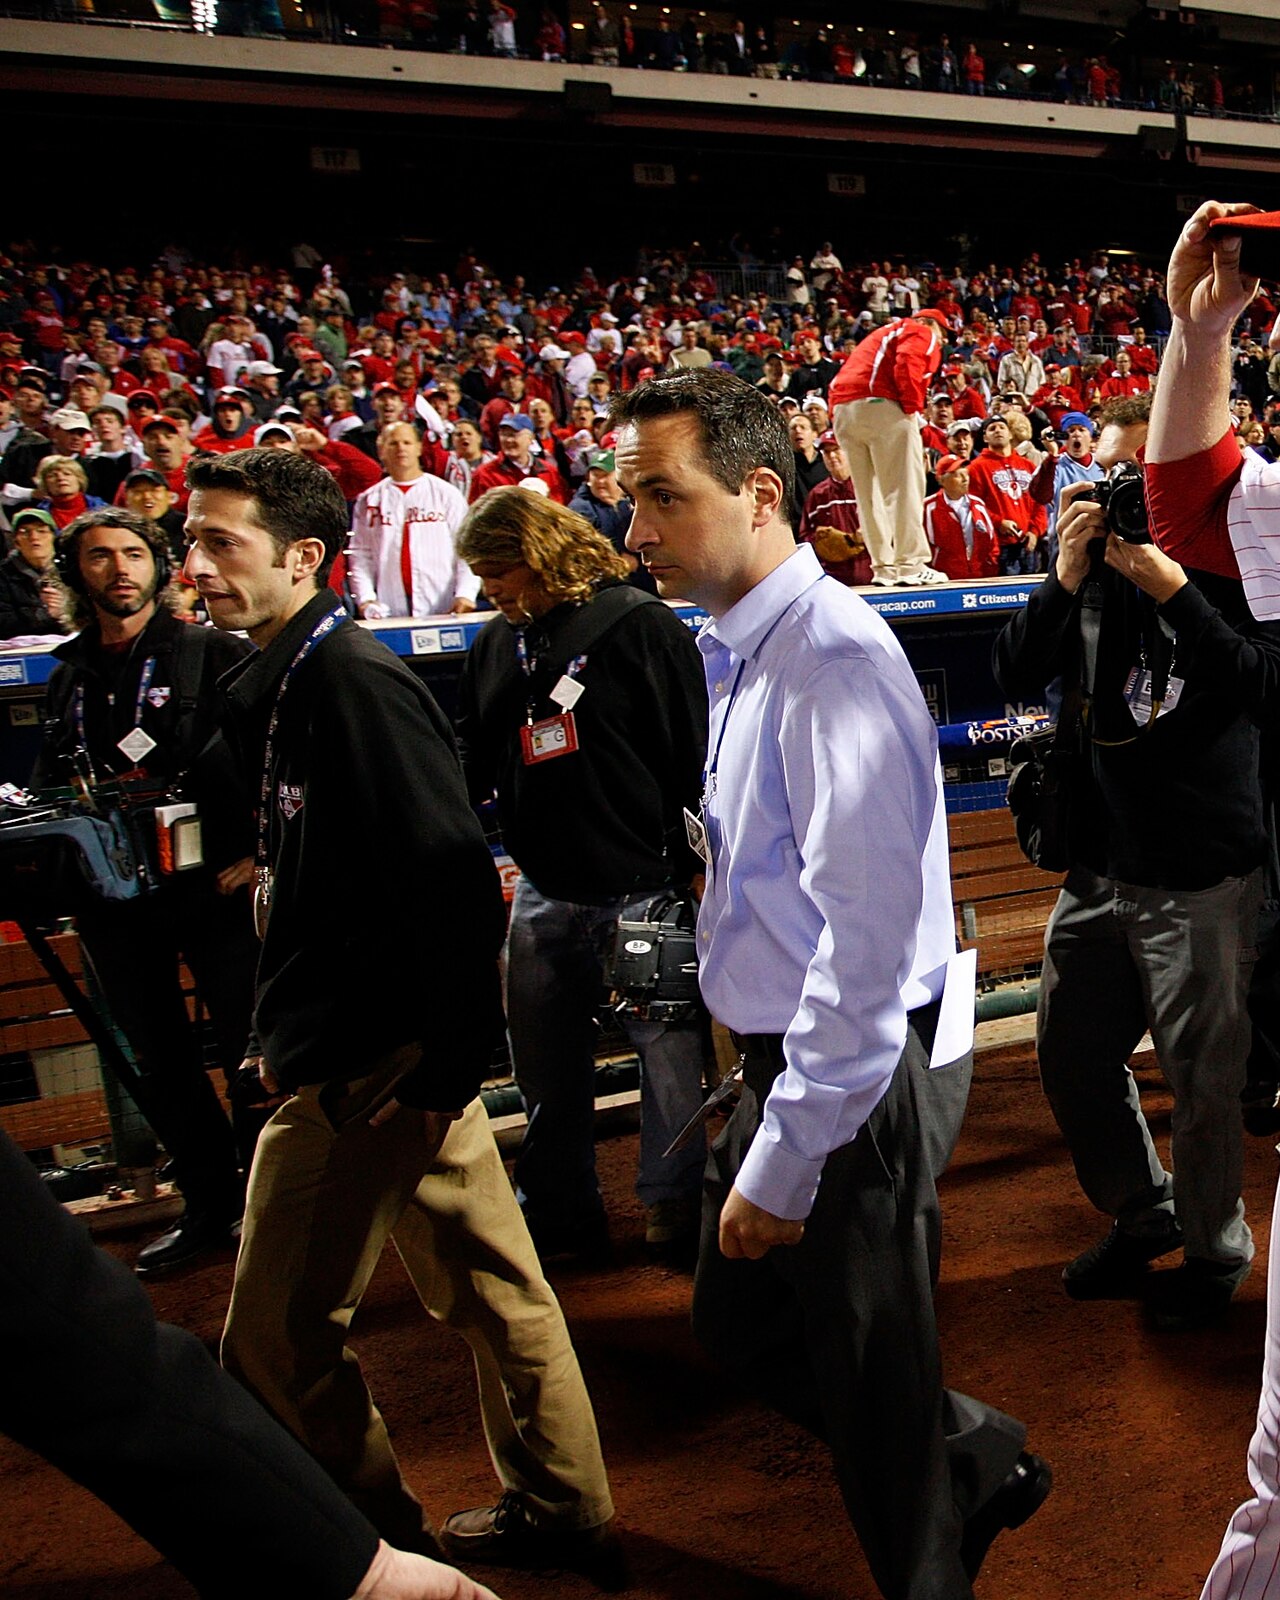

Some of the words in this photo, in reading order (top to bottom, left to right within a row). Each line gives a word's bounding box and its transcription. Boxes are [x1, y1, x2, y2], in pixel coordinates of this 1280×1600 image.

[837, 177, 857, 190] 119
[979, 593, 1017, 605] Citizens
[1125, 672, 1139, 694] MEDIA
[553, 730, 565, 742] G
